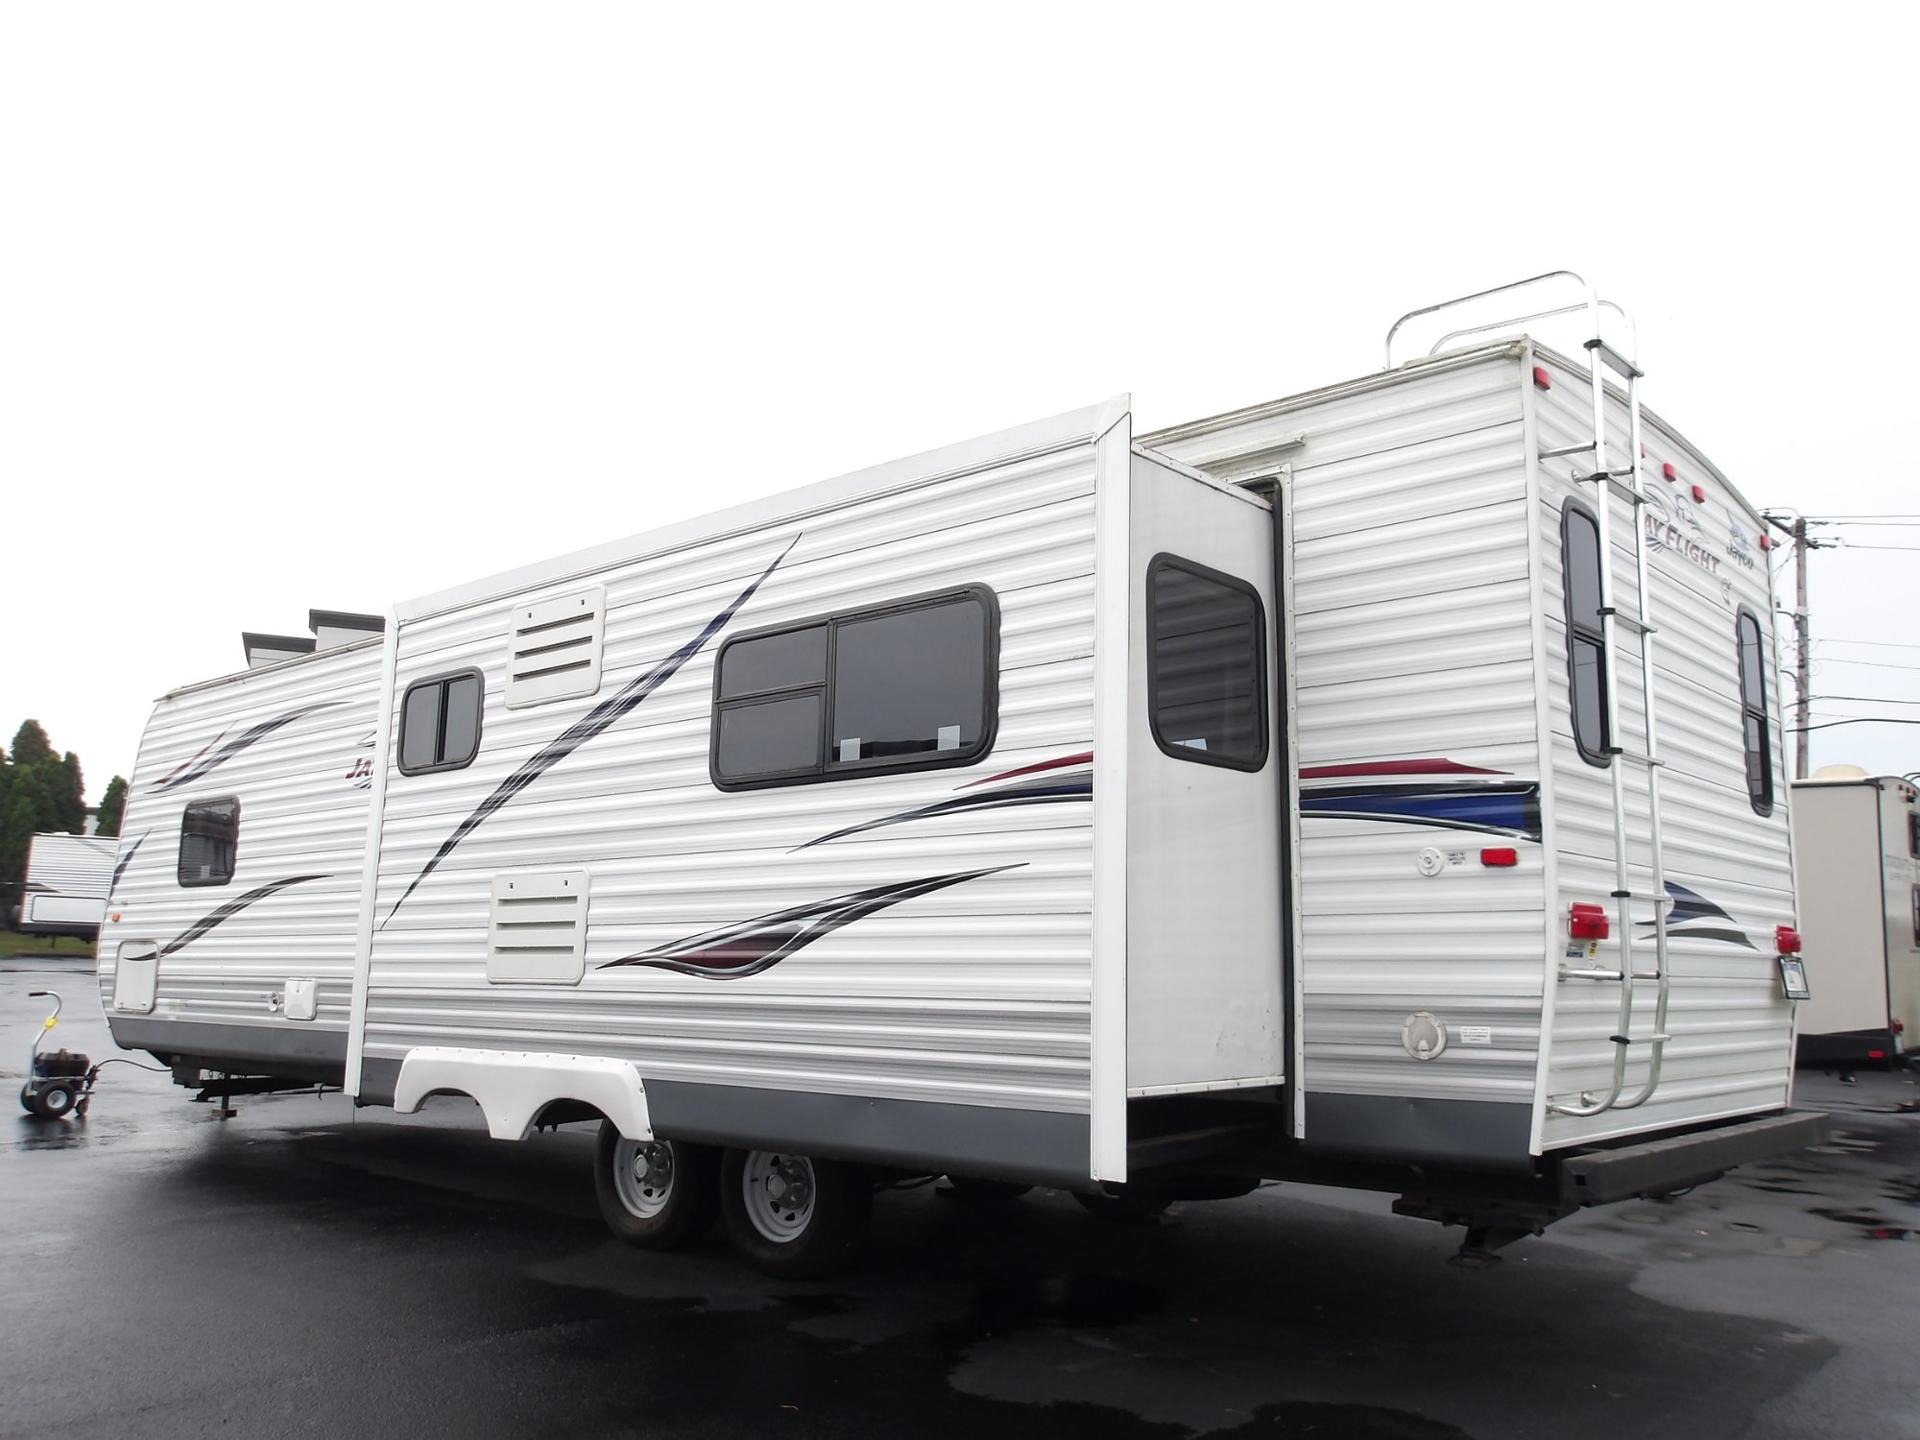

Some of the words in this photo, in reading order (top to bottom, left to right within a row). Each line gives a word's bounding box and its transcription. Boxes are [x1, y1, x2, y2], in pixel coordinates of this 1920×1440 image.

[1644, 513, 1665, 537] AY
[1665, 524, 1720, 574] FLIGHT
[345, 758, 374, 778] JA
